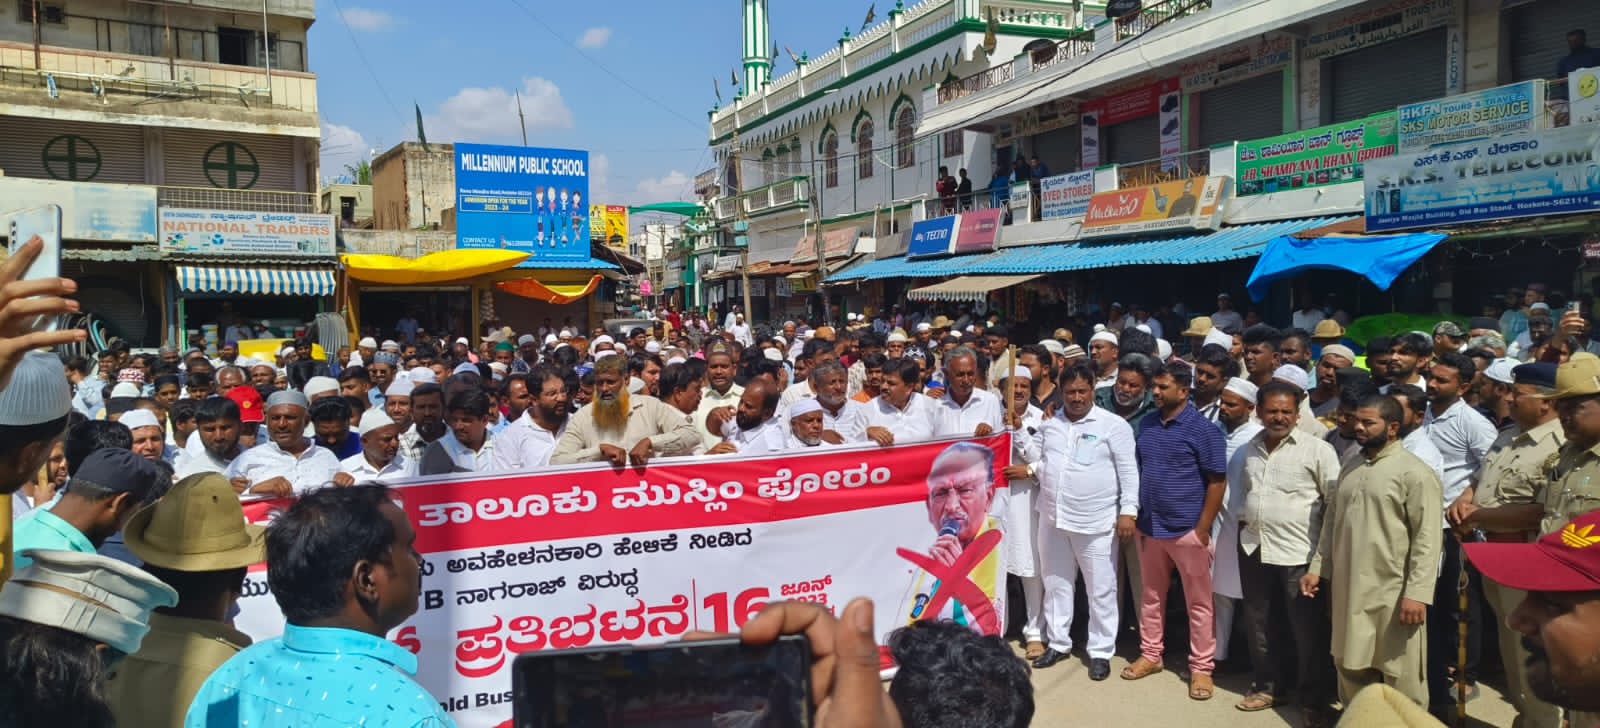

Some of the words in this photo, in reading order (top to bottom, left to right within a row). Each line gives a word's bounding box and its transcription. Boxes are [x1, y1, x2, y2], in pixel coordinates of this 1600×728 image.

[1400, 104, 1441, 120] HKFN
[1443, 102, 1473, 114] TOURS
[1402, 120, 1425, 134] SKS
[1427, 111, 1470, 130] MOTOR
[1473, 101, 1530, 122] SERVICE
[461, 153, 517, 173] MILLENNIUM
[519, 156, 549, 174] PUBLIC
[552, 158, 586, 177] SCHOOL
[1261, 158, 1320, 178] SHAMIYANA
[1322, 151, 1353, 169] KHAN
[1376, 166, 1444, 189] S.K.S.
[1454, 146, 1593, 179] TELECOM
[1042, 190, 1062, 202] SYED
[1063, 184, 1093, 199] STORES
[1458, 206, 1472, 216] Old
[1474, 205, 1488, 214] Bus
[163, 221, 250, 234] NATIONAL
[255, 223, 330, 236] TRADERS
[926, 229, 948, 241] TECNO
[418, 485, 598, 527] ತಾಲೂಕು
[611, 478, 744, 513] ಮುಸ್ಲಿಂ
[446, 542, 603, 573] ಅವಹೇಳನಕಾರಿ
[689, 527, 753, 551] ನೀಡಿದ
[456, 576, 567, 606] ನಾಗರಾಜ್
[577, 567, 639, 598] ವಿರುದ್ಧ
[780, 574, 833, 596] ಜೂನ್
[455, 594, 689, 679] ಪ್ರತಿಭಟನೆ
[703, 587, 770, 635] 16
